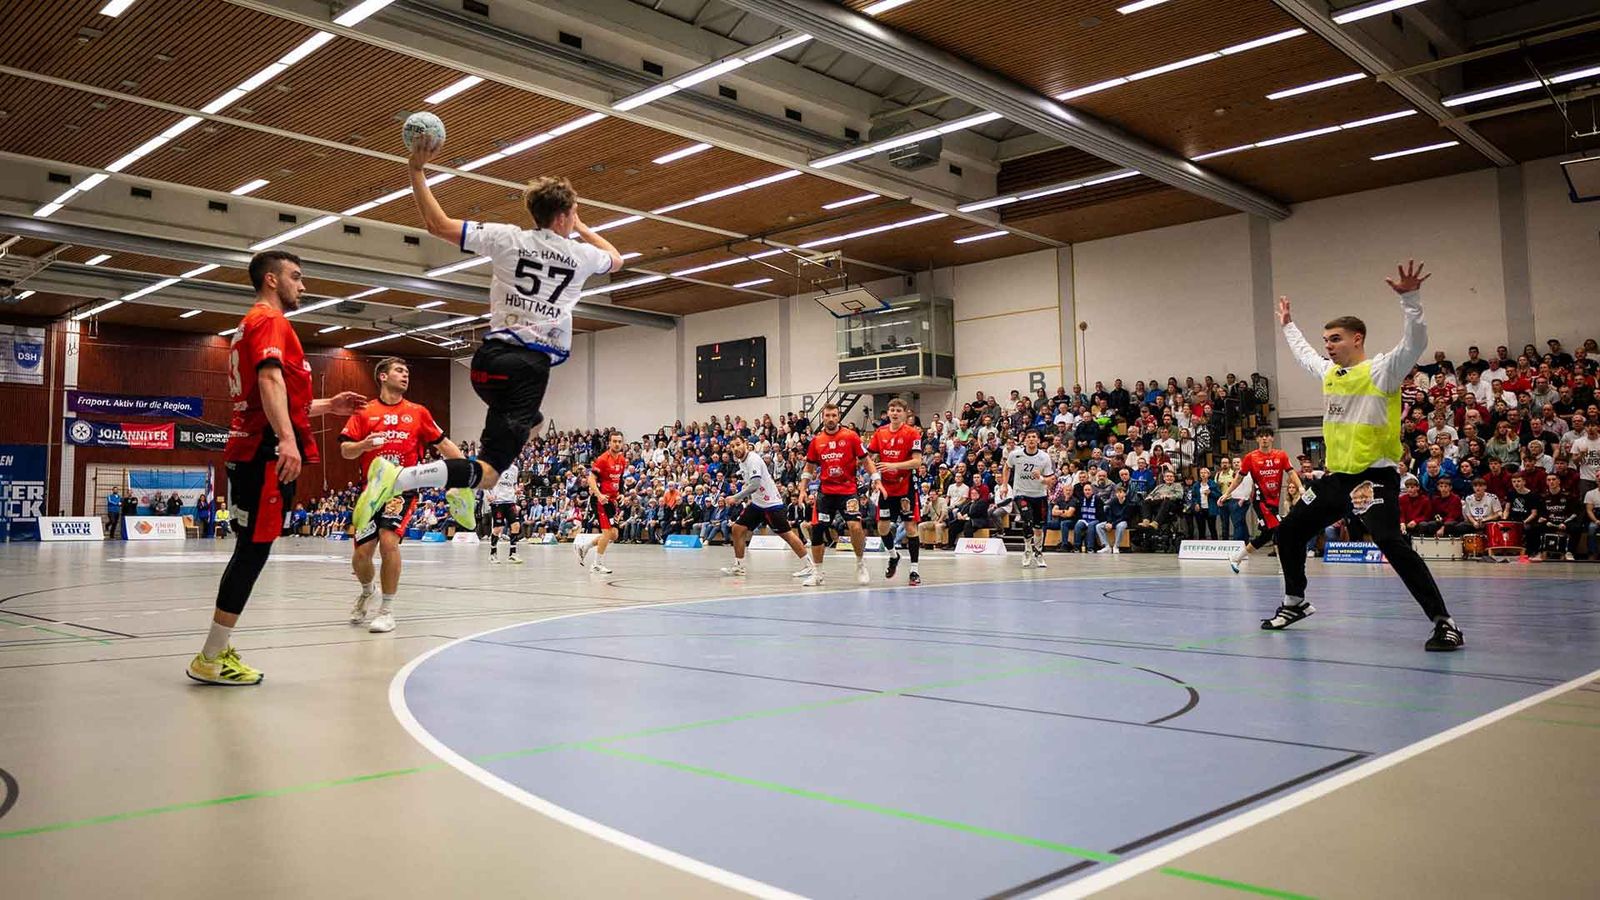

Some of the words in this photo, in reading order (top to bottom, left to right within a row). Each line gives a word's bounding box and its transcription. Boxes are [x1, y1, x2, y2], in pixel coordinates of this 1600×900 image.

[541, 250, 578, 268] HANAU
[514, 258, 575, 304] 57
[18, 352, 37, 361] DSH
[1029, 371, 1046, 393] B
[77, 396, 111, 407] Fraport.
[113, 399, 134, 408] Aktiv
[136, 400, 148, 408] für
[150, 401, 162, 409] die
[163, 401, 192, 411] Region.
[383, 414, 399, 425] 38
[98, 428, 168, 440] JOHANNITER
[1023, 463, 1035, 472] 27
[1474, 507, 1484, 515] 33
